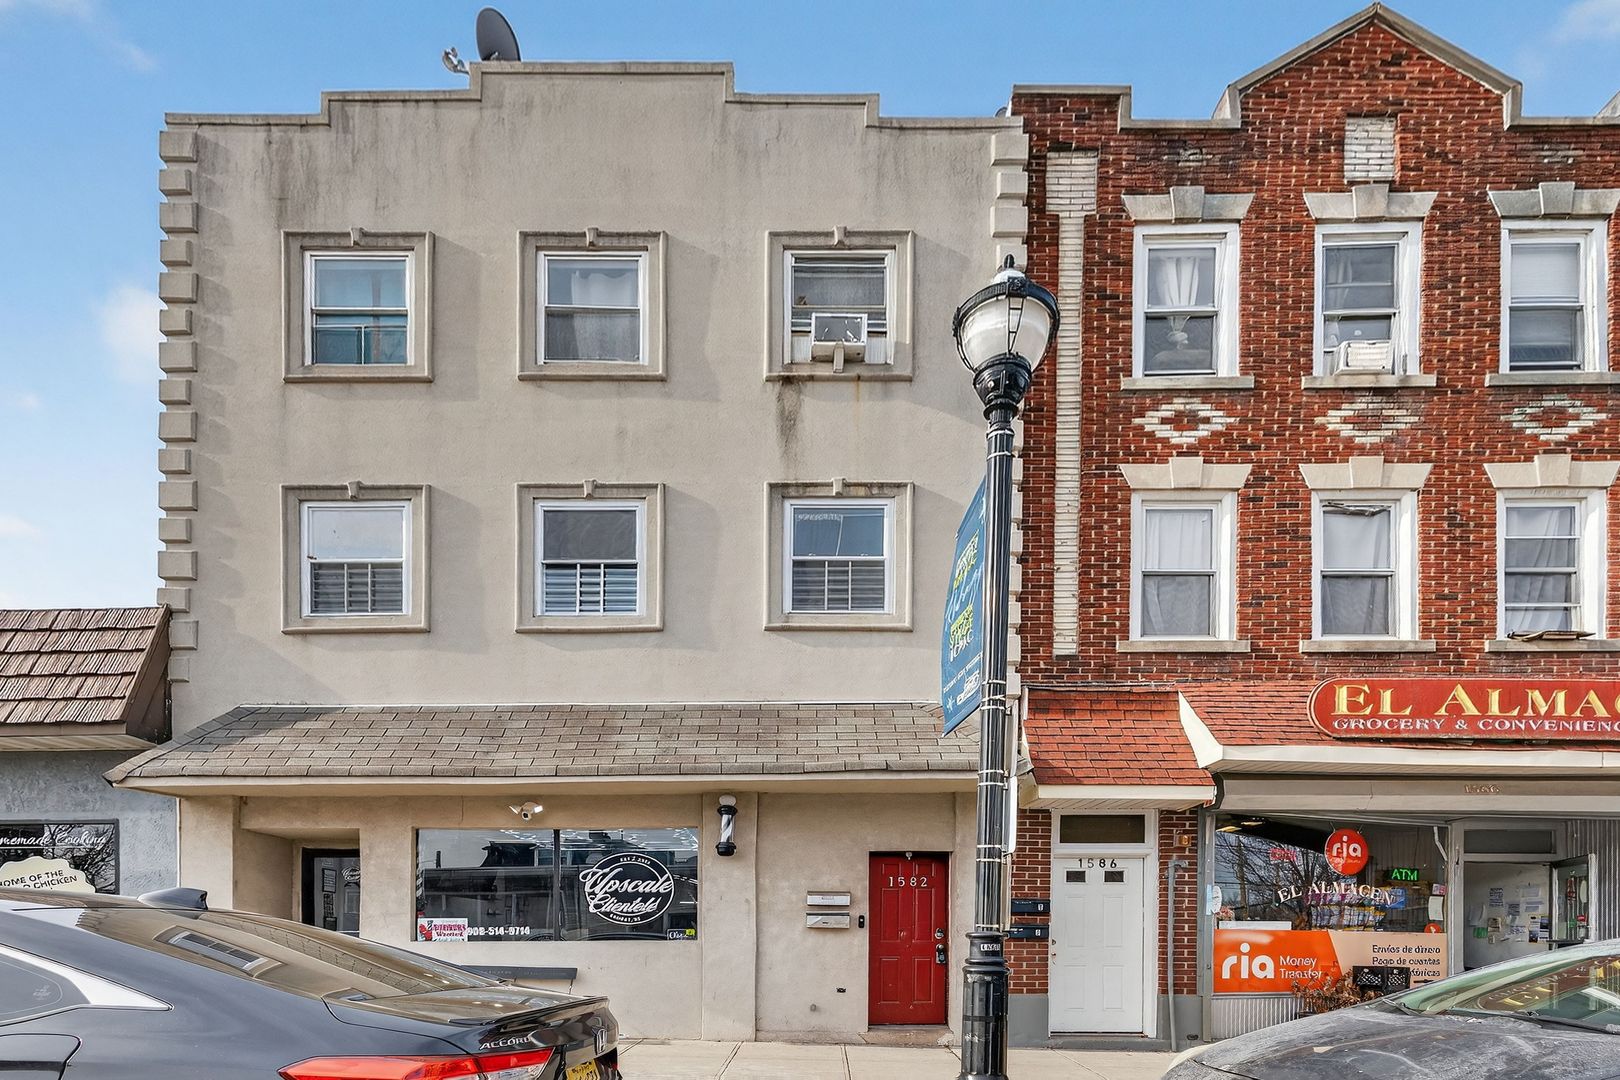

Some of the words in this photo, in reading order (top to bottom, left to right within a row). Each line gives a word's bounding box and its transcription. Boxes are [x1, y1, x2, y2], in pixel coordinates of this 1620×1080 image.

[1331, 683, 1413, 716] EL
[1433, 682, 1620, 717] ALMA
[1332, 717, 1445, 731] GROCERY
[1454, 718, 1469, 731] &
[1332, 835, 1362, 857] ria
[1078, 858, 1118, 869] 1586
[29, 873, 43, 882] OF
[44, 869, 64, 879] THE
[34, 875, 78, 889] CHICKEN
[579, 867, 674, 894] Upscale
[889, 876, 928, 887] 1582
[1391, 869, 1418, 881] ATM
[1277, 884, 1303, 904] EL
[1402, 945, 1414, 953] de
[1221, 942, 1275, 979] ria
[1280, 955, 1317, 969] Money
[1396, 956, 1408, 965] de
[1280, 968, 1322, 980] Transfer
[479, 1036, 531, 1050] ACCORD
